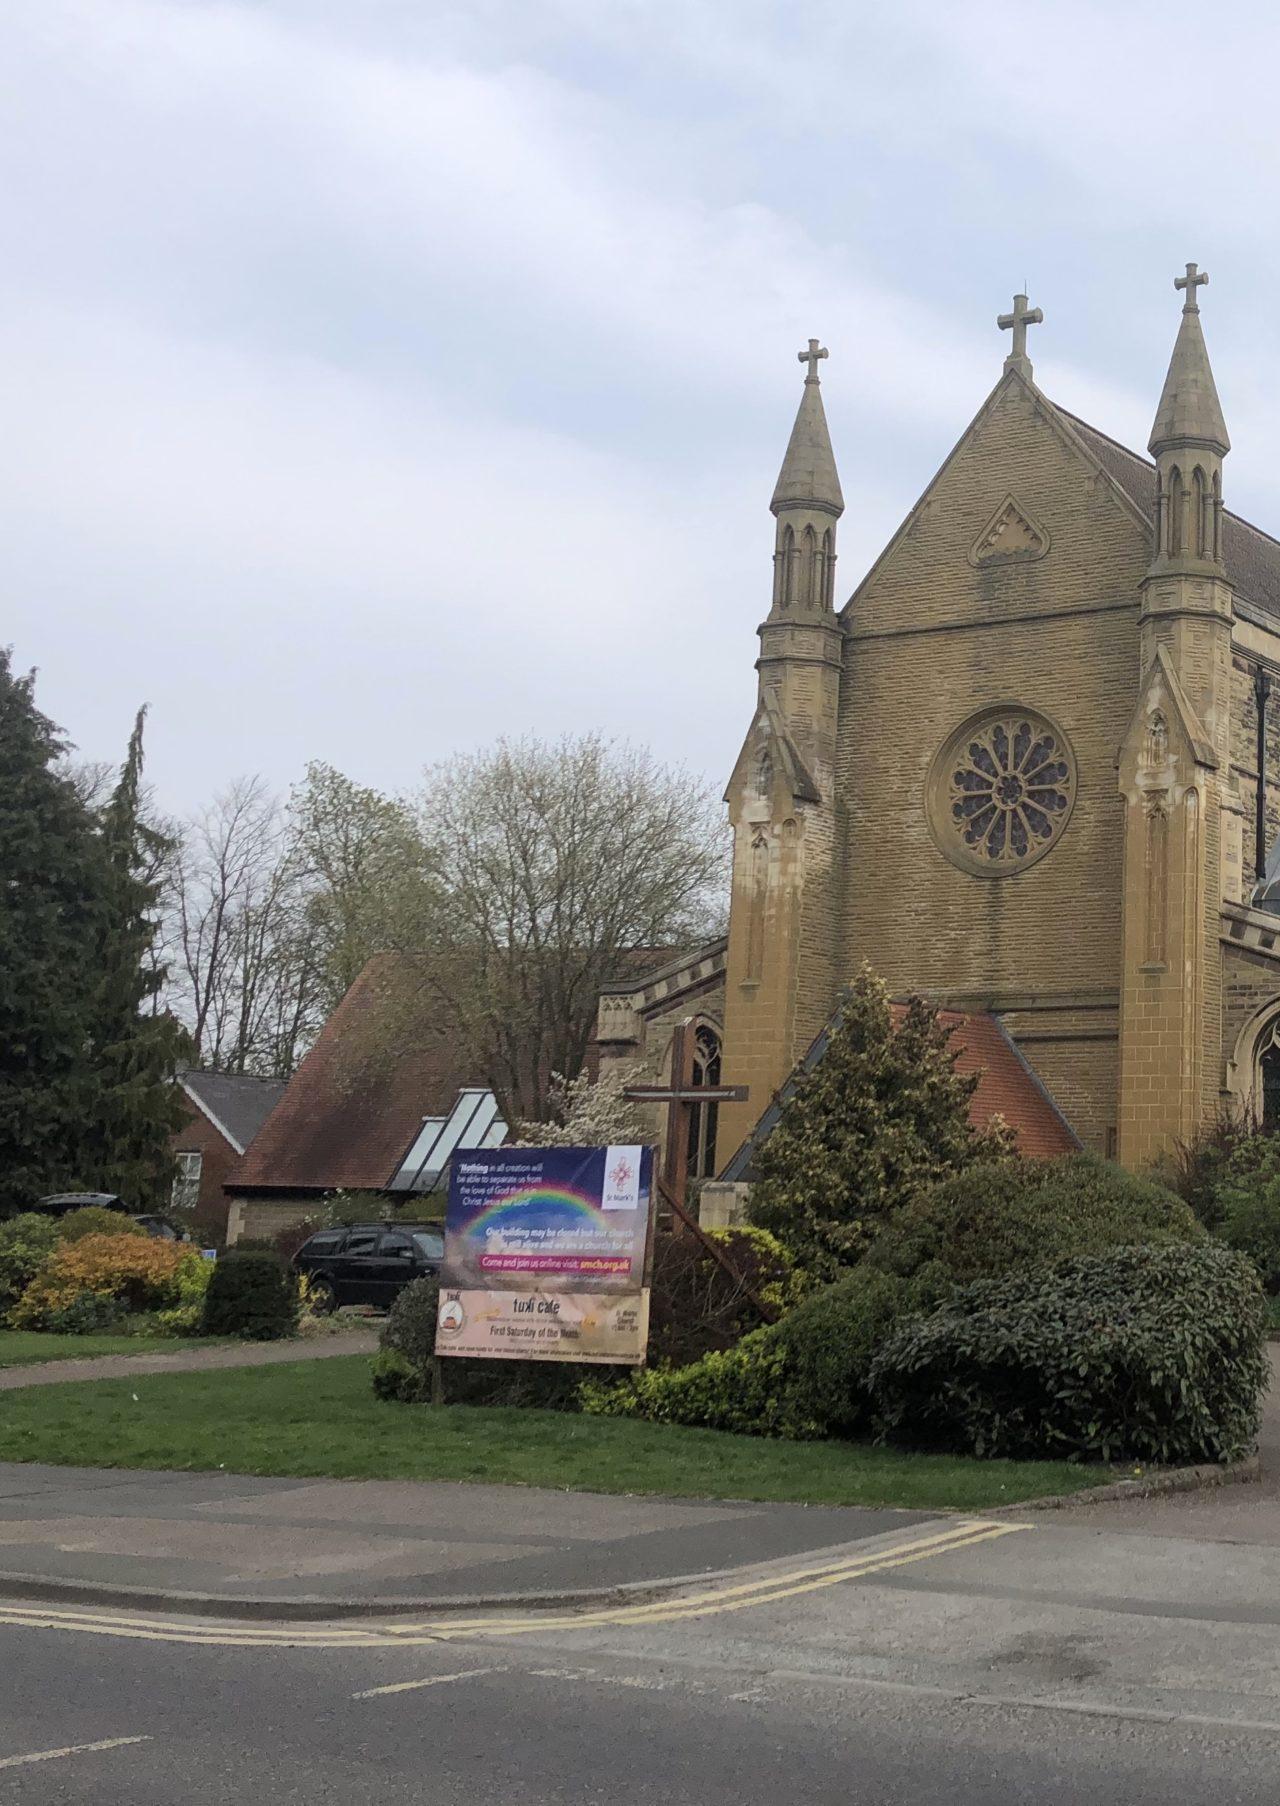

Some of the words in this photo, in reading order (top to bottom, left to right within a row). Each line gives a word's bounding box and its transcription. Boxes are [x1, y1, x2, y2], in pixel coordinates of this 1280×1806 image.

[496, 1164, 505, 1172] all
[505, 1164, 530, 1172] creation
[532, 1163, 543, 1172] will
[457, 1175, 466, 1183] be
[466, 1175, 481, 1183] able
[490, 1176, 517, 1185] separate
[526, 1175, 542, 1183] from
[471, 1186, 486, 1194] love
[486, 1186, 493, 1194] of
[494, 1186, 510, 1194] God
[462, 1197, 482, 1205] Christ
[482, 1197, 500, 1206] Jesus
[486, 1228, 501, 1236] Our
[501, 1227, 530, 1239] building
[530, 1229, 546, 1239] may
[546, 1228, 556, 1236] be
[557, 1228, 580, 1237] closed
[581, 1228, 593, 1237] but
[609, 1229, 634, 1238] church
[541, 1241, 553, 1249] and
[584, 1241, 609, 1250] church
[612, 1241, 623, 1250] for
[624, 1241, 633, 1249] all
[482, 1257, 502, 1267] Come
[503, 1257, 517, 1267] and
[517, 1258, 529, 1270] join
[539, 1258, 561, 1268] online
[490, 1326, 505, 1335] First
[507, 1326, 536, 1338] Saturday
[538, 1328, 545, 1337] of
[547, 1329, 558, 1338] the
